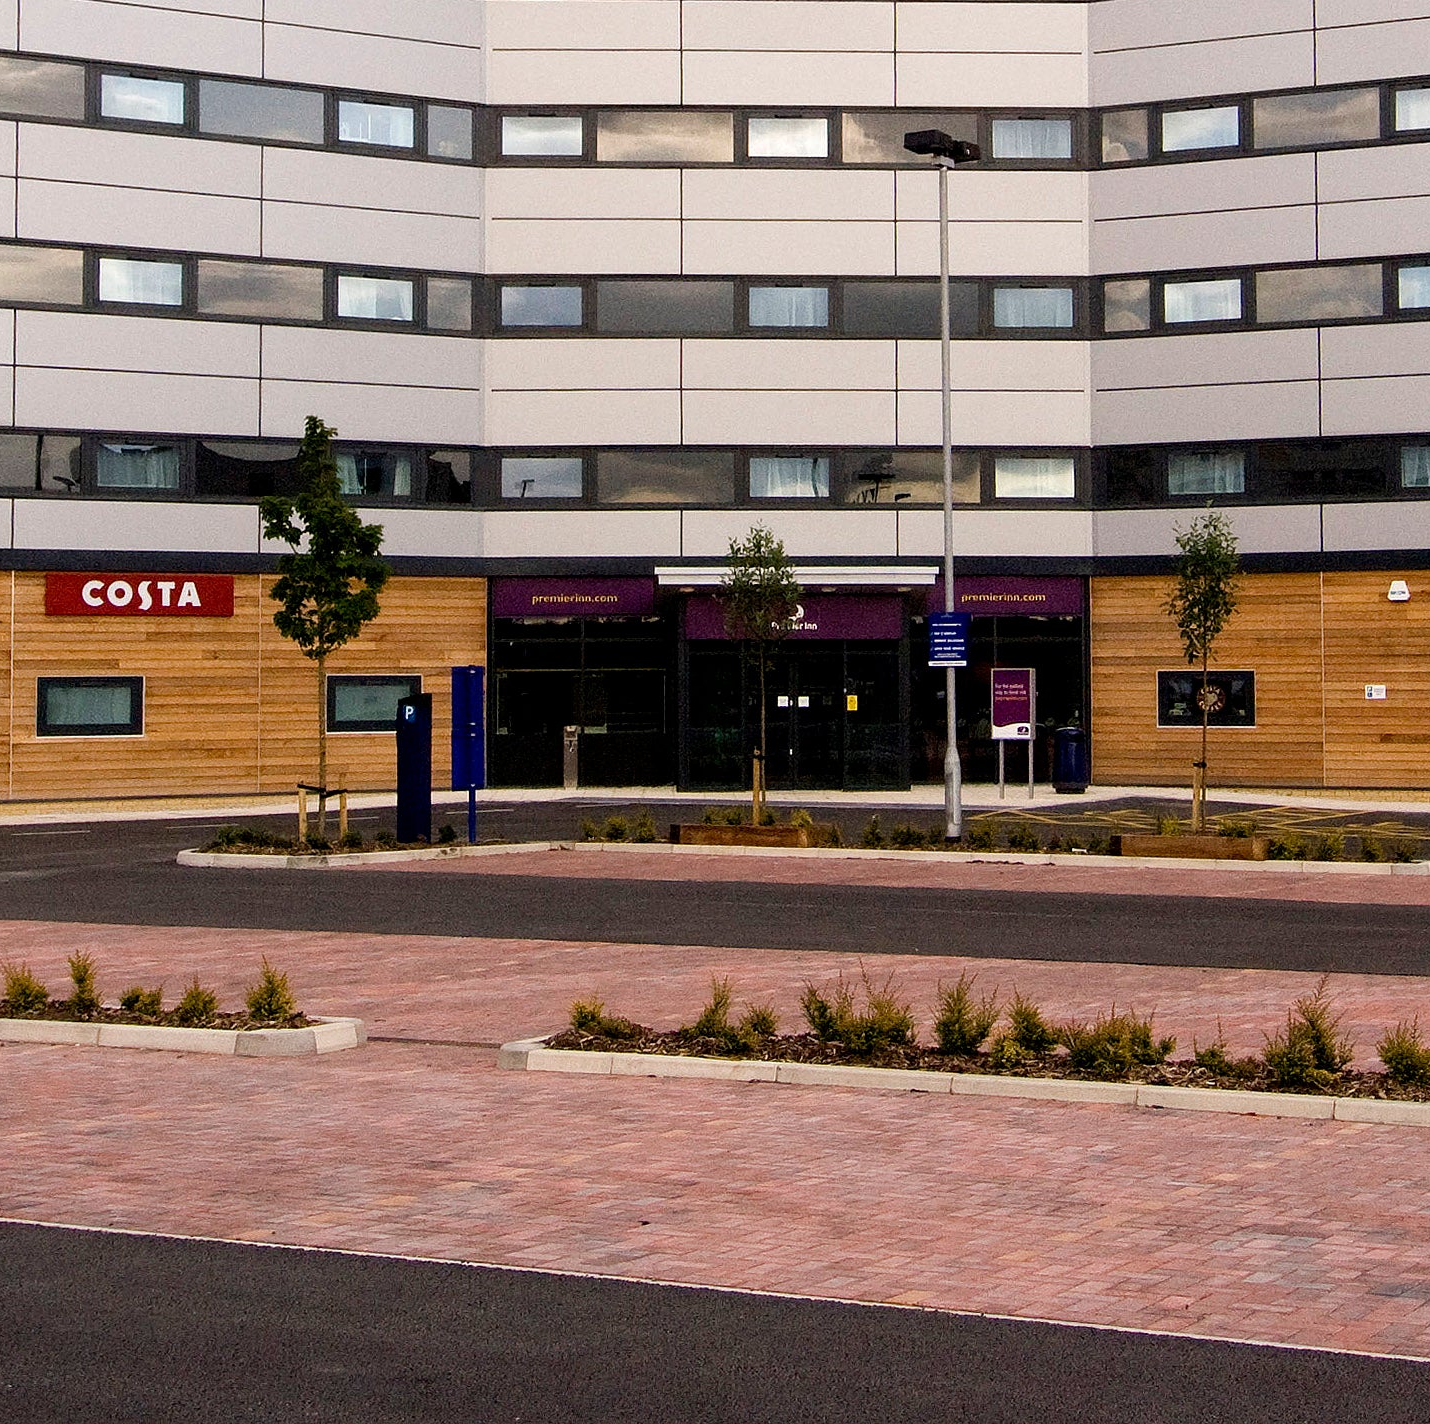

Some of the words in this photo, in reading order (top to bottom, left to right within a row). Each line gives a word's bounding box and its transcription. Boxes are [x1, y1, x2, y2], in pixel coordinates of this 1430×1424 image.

[82, 580, 201, 610] COSTA
[531, 593, 618, 605] premierinn.com
[961, 592, 1046, 602] premierinn.com
[771, 621, 803, 630] Prier
[804, 621, 818, 630] Inn
[405, 705, 414, 720] P
